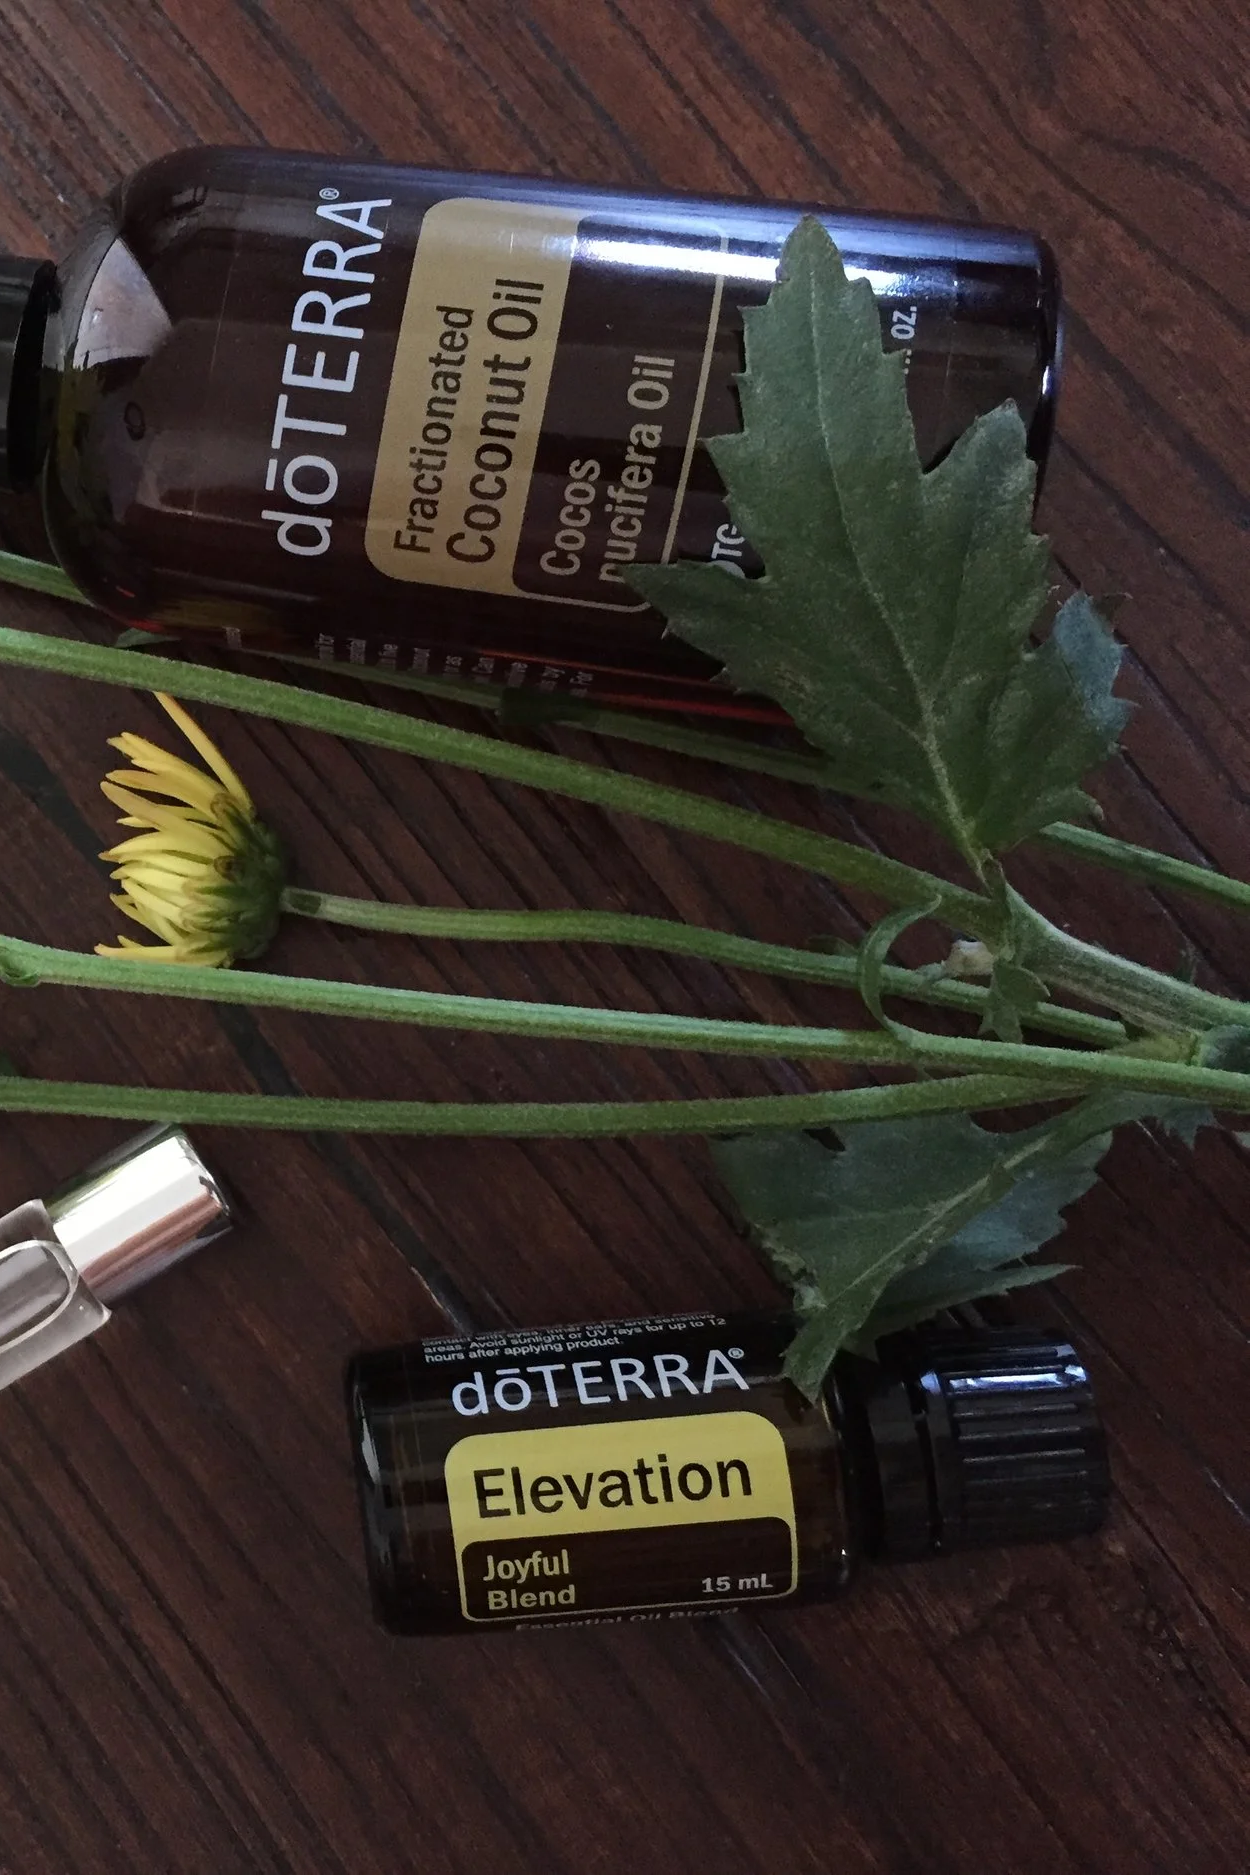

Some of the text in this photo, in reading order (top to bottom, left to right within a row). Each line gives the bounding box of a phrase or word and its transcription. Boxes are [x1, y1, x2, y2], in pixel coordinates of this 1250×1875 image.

[393, 305, 475, 553] Fractionated
[446, 278, 545, 563] Coconut Oil
[598, 355, 675, 583] nucifera Oil
[540, 459, 600, 576] Cocos
[425, 1337, 624, 1363] hours after applying product.
[470, 1339, 507, 1349] Avoid
[510, 1333, 564, 1345] sunlight
[568, 1332, 582, 1340] or
[586, 1329, 607, 1338] UV
[613, 1326, 643, 1337] rays
[646, 1324, 664, 1332] for
[669, 1322, 686, 1332] up
[710, 1318, 726, 1326] 12
[473, 1453, 753, 1519] Elevation
[483, 1549, 570, 1584] Joyful
[702, 1573, 774, 1593] 15 mL
[487, 1584, 575, 1611] Blend
